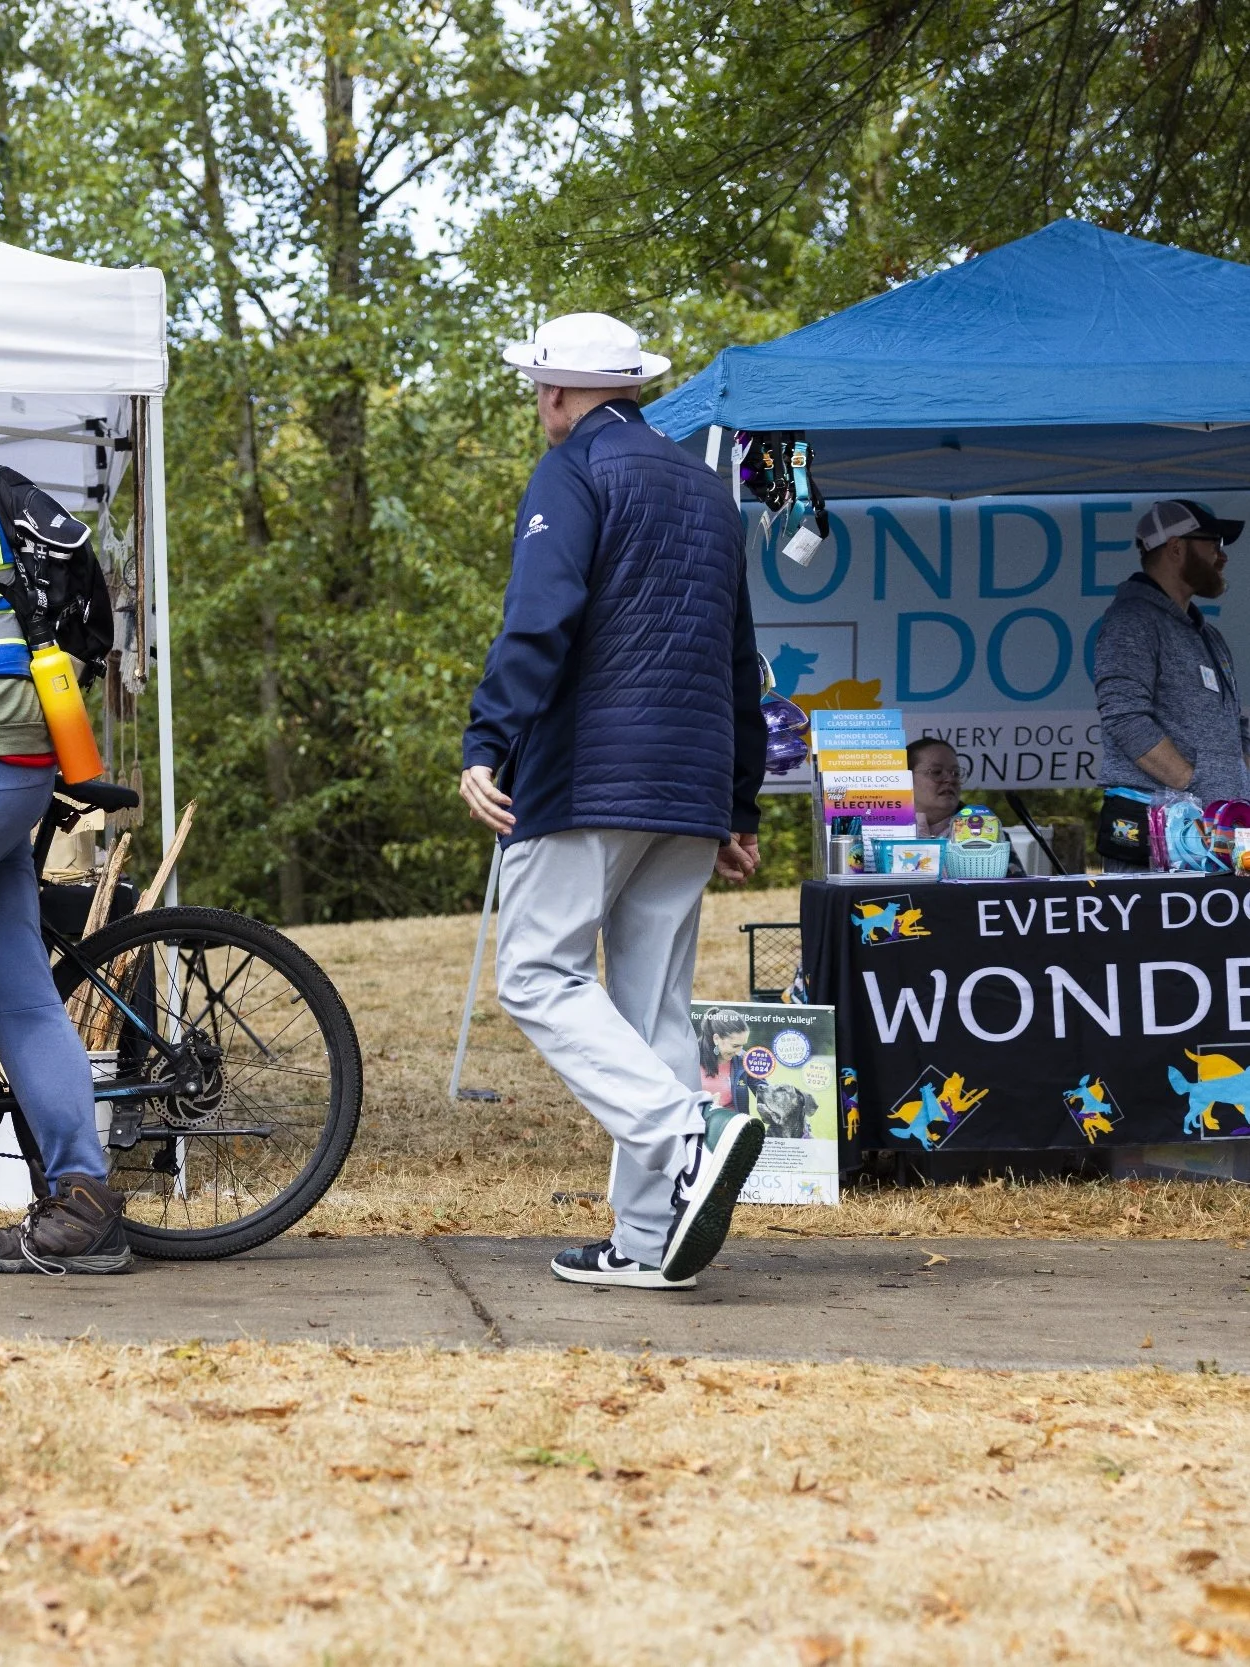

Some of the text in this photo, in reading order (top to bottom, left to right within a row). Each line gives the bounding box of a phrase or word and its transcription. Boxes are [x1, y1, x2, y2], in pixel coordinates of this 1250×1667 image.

[744, 501, 1216, 603] ONDE
[895, 607, 1220, 702] DO
[1015, 726, 1073, 746] DOG
[833, 775, 900, 783] WONDER DOGS
[957, 751, 1097, 782] NDER
[834, 801, 902, 809] ELECTIVES
[978, 888, 1250, 937] EVERY DO
[862, 957, 1250, 1043] WONDE
[691, 1012, 702, 1020] for
[703, 1012, 729, 1022] voting
[762, 1014, 771, 1022] of
[772, 1015, 786, 1023] the
[748, 1174, 782, 1188] OGS
